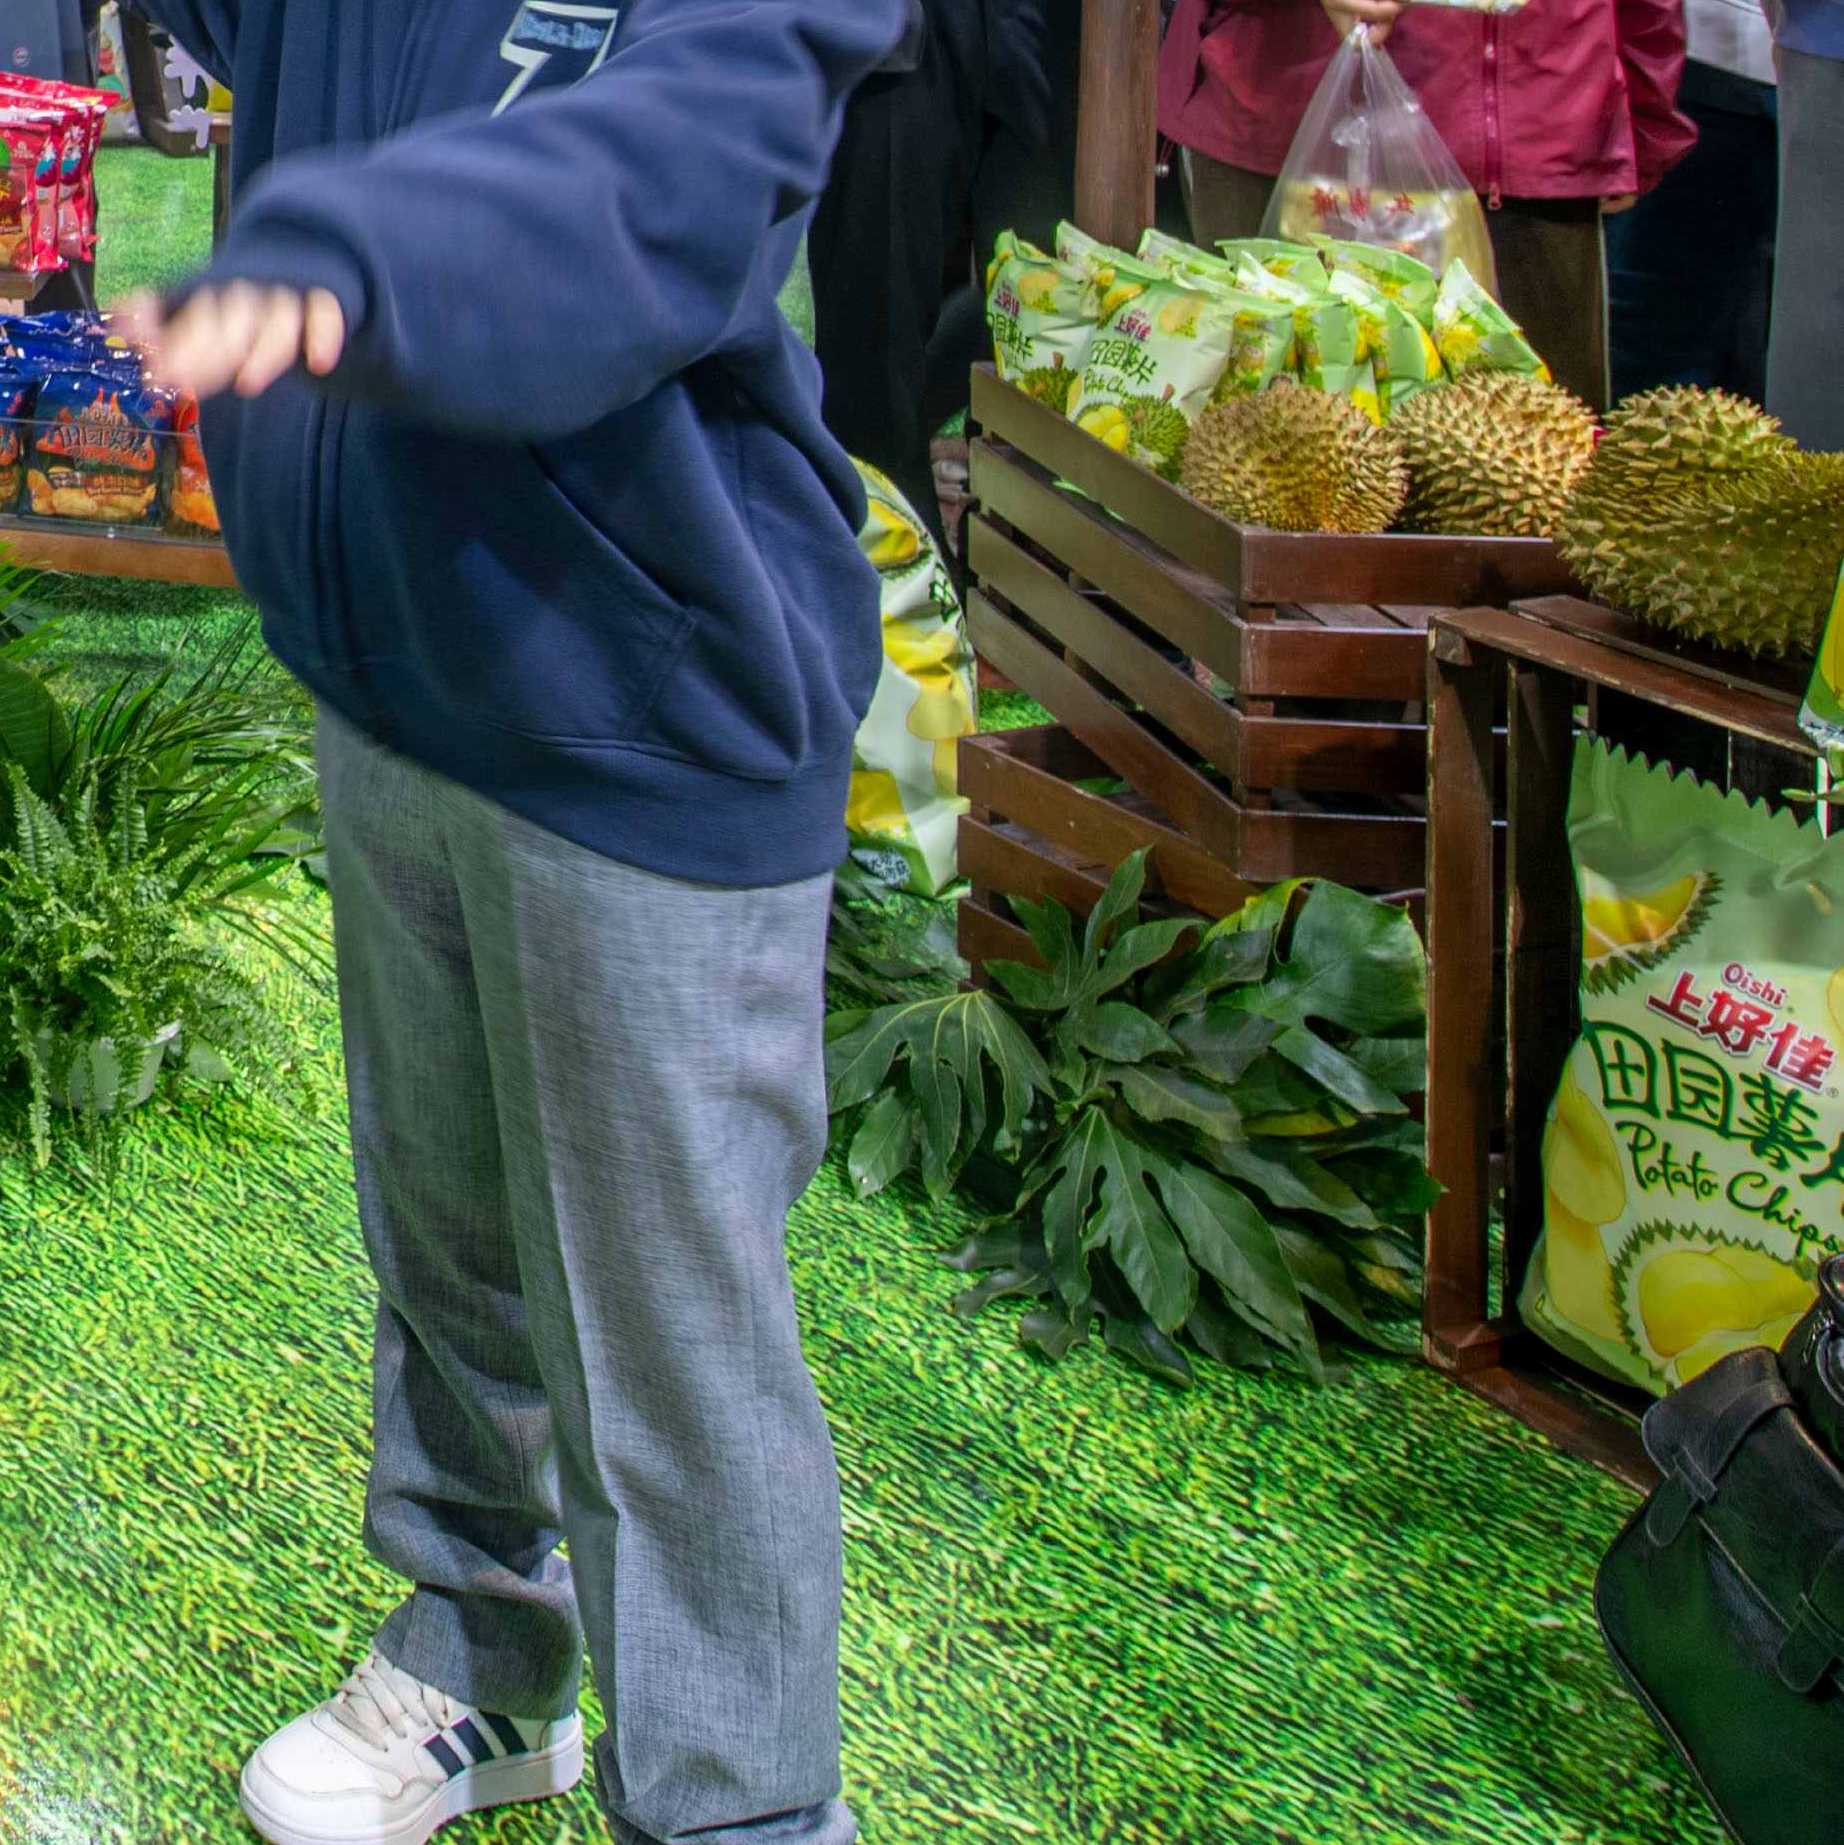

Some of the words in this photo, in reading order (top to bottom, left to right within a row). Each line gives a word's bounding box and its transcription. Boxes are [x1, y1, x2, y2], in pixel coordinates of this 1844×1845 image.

[1722, 961, 1787, 1007] Oishi
[1646, 970, 1835, 1092] 上好佳
[1615, 1120, 1719, 1200] Potato
